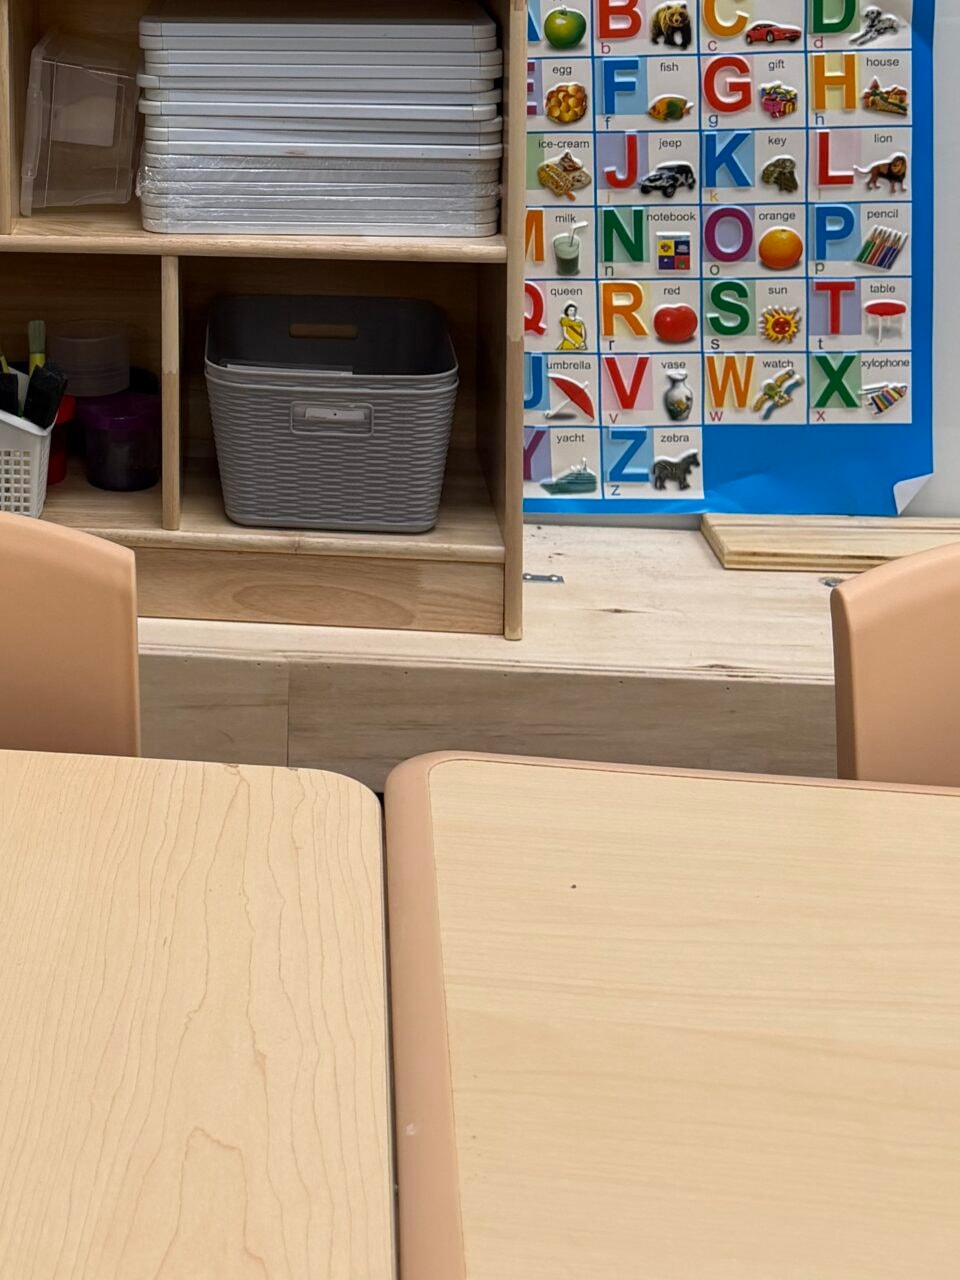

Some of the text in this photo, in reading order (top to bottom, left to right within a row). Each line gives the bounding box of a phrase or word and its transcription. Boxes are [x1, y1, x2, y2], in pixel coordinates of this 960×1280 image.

[813, 35, 824, 49] d
[601, 41, 611, 55] b
[660, 62, 679, 72] fish
[768, 60, 785, 71] gift
[866, 57, 900, 67] house
[552, 66, 572, 76] egg
[602, 59, 639, 114] F
[703, 55, 752, 113] G
[812, 53, 857, 109] H
[605, 117, 612, 129] f
[708, 115, 719, 127] g
[815, 114, 824, 125] h
[538, 139, 590, 149] ice-cream
[768, 136, 787, 147] key
[874, 134, 893, 143] lion
[658, 139, 682, 150] jeep
[604, 131, 638, 188] J
[704, 131, 753, 187] K
[817, 130, 854, 185] L
[710, 190, 719, 202] k
[555, 213, 576, 223] milk
[646, 211, 696, 222] notebook
[758, 212, 796, 222] orange
[867, 209, 899, 219] pencil
[602, 208, 644, 262] N
[704, 206, 753, 263] O
[815, 205, 855, 260] P
[606, 265, 614, 276] n
[815, 262, 824, 274] p
[550, 287, 583, 297] queen
[663, 286, 681, 296] red
[768, 286, 788, 295] sun
[869, 284, 896, 294] table
[602, 282, 649, 336] R
[708, 280, 750, 336] S
[814, 281, 856, 334] T
[608, 339, 615, 350] r
[817, 338, 823, 349] t
[546, 361, 592, 370] umbrella
[762, 359, 794, 369] watch
[862, 360, 910, 369] xylophone
[604, 356, 649, 410] V
[705, 355, 755, 408] W
[813, 354, 858, 408] X
[556, 433, 585, 444] yacht
[660, 433, 689, 443] zebra
[608, 430, 649, 483] Z
